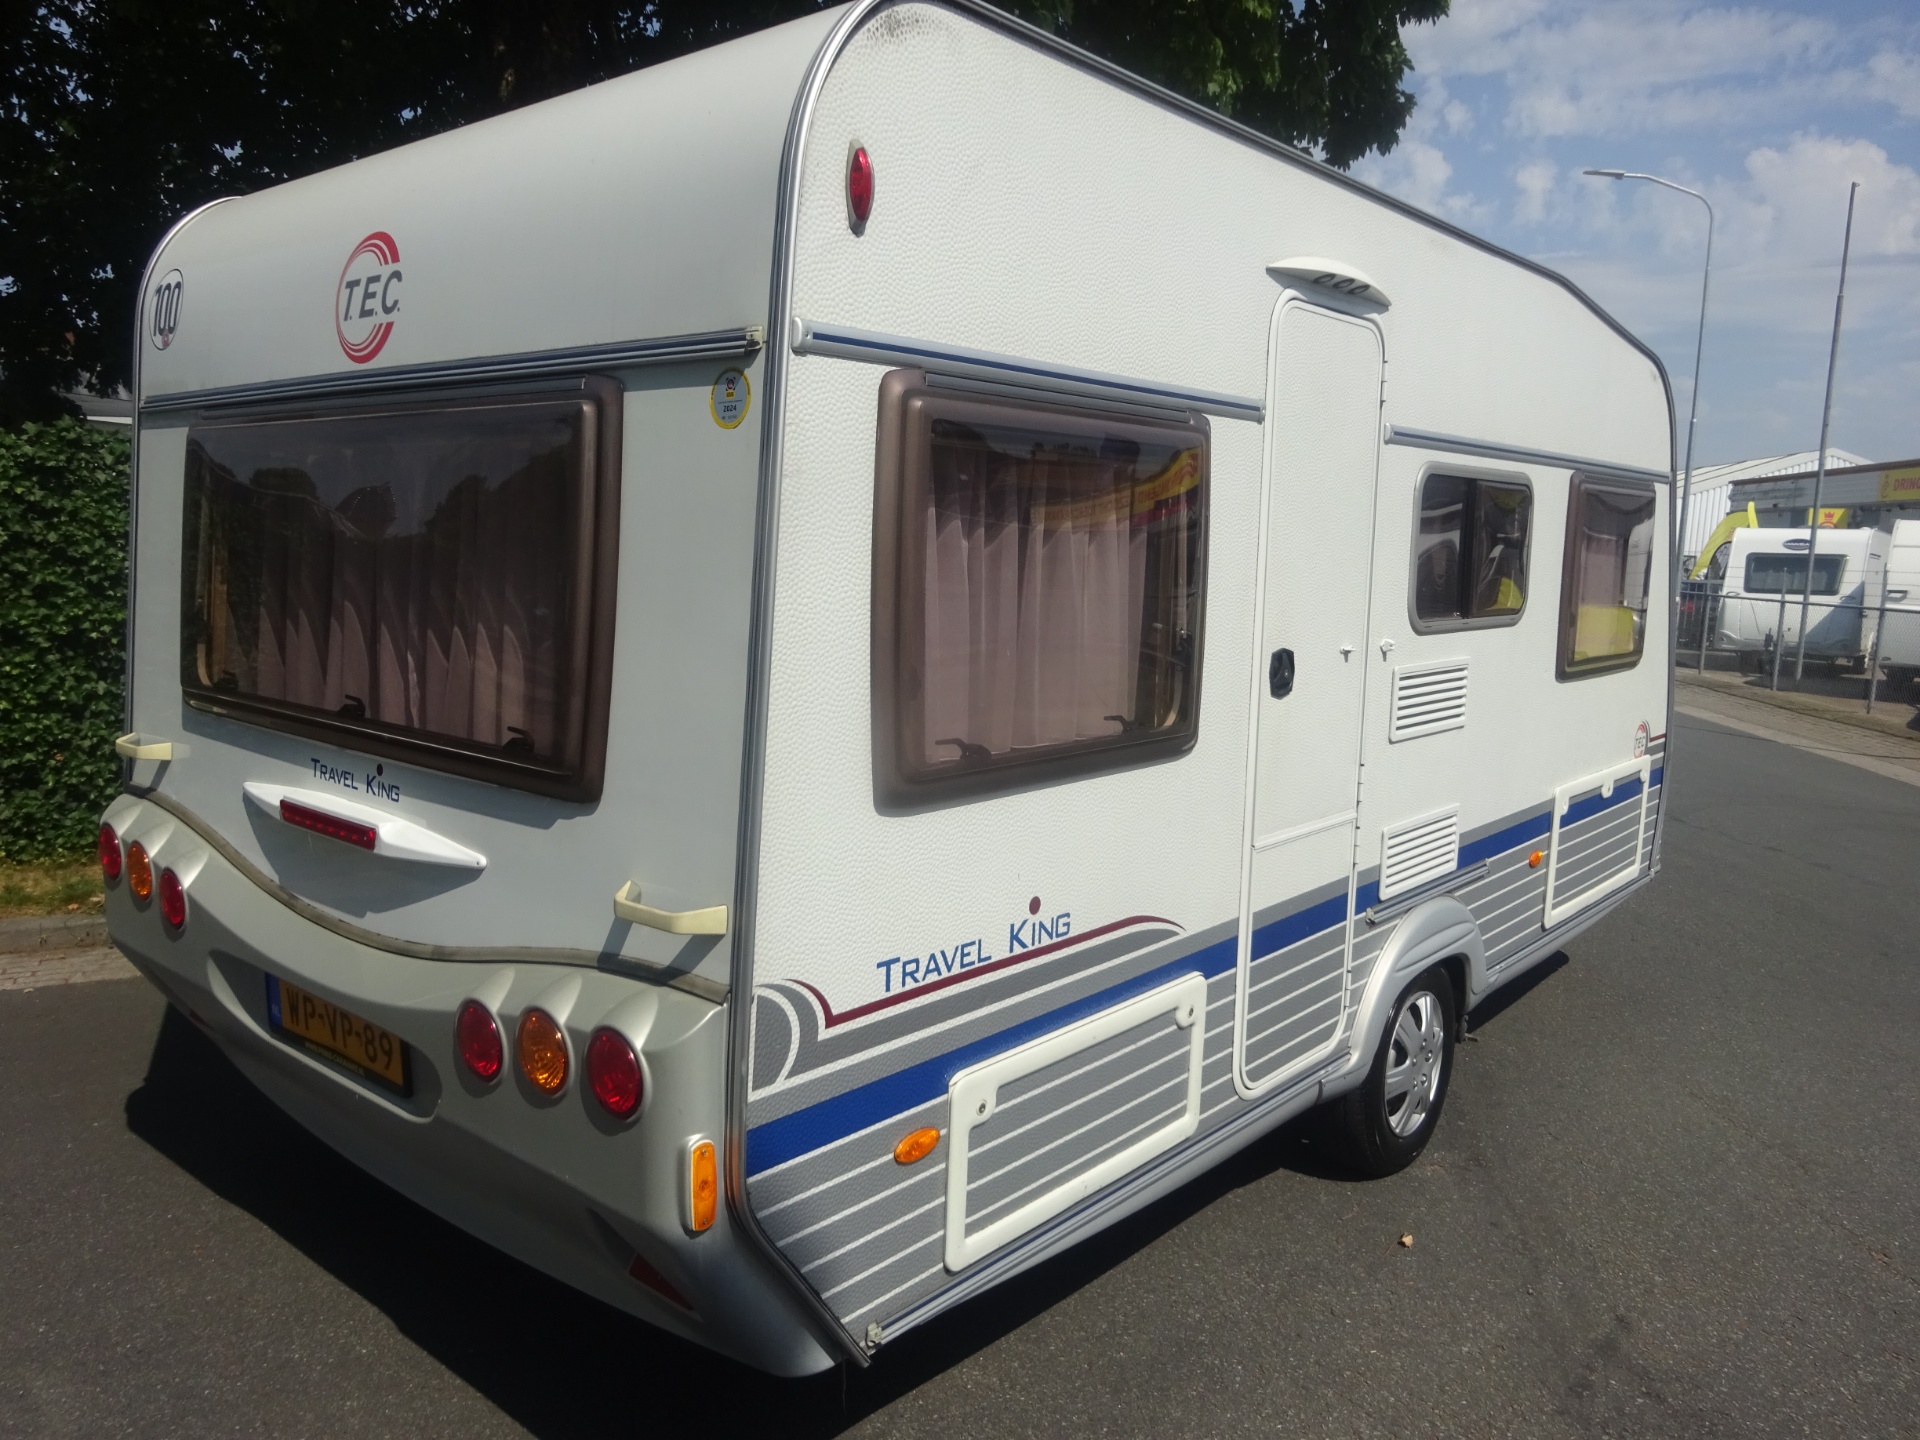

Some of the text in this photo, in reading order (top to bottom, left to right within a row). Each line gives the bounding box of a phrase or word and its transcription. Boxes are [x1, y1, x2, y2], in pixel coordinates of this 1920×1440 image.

[153, 281, 182, 336] 100
[343, 270, 403, 322] T.E.C.
[723, 404, 737, 412] 2024
[311, 758, 400, 803] TRAVEL KING
[876, 909, 1071, 993] TRAVEL KING
[285, 987, 393, 1071] WP-VP-89
